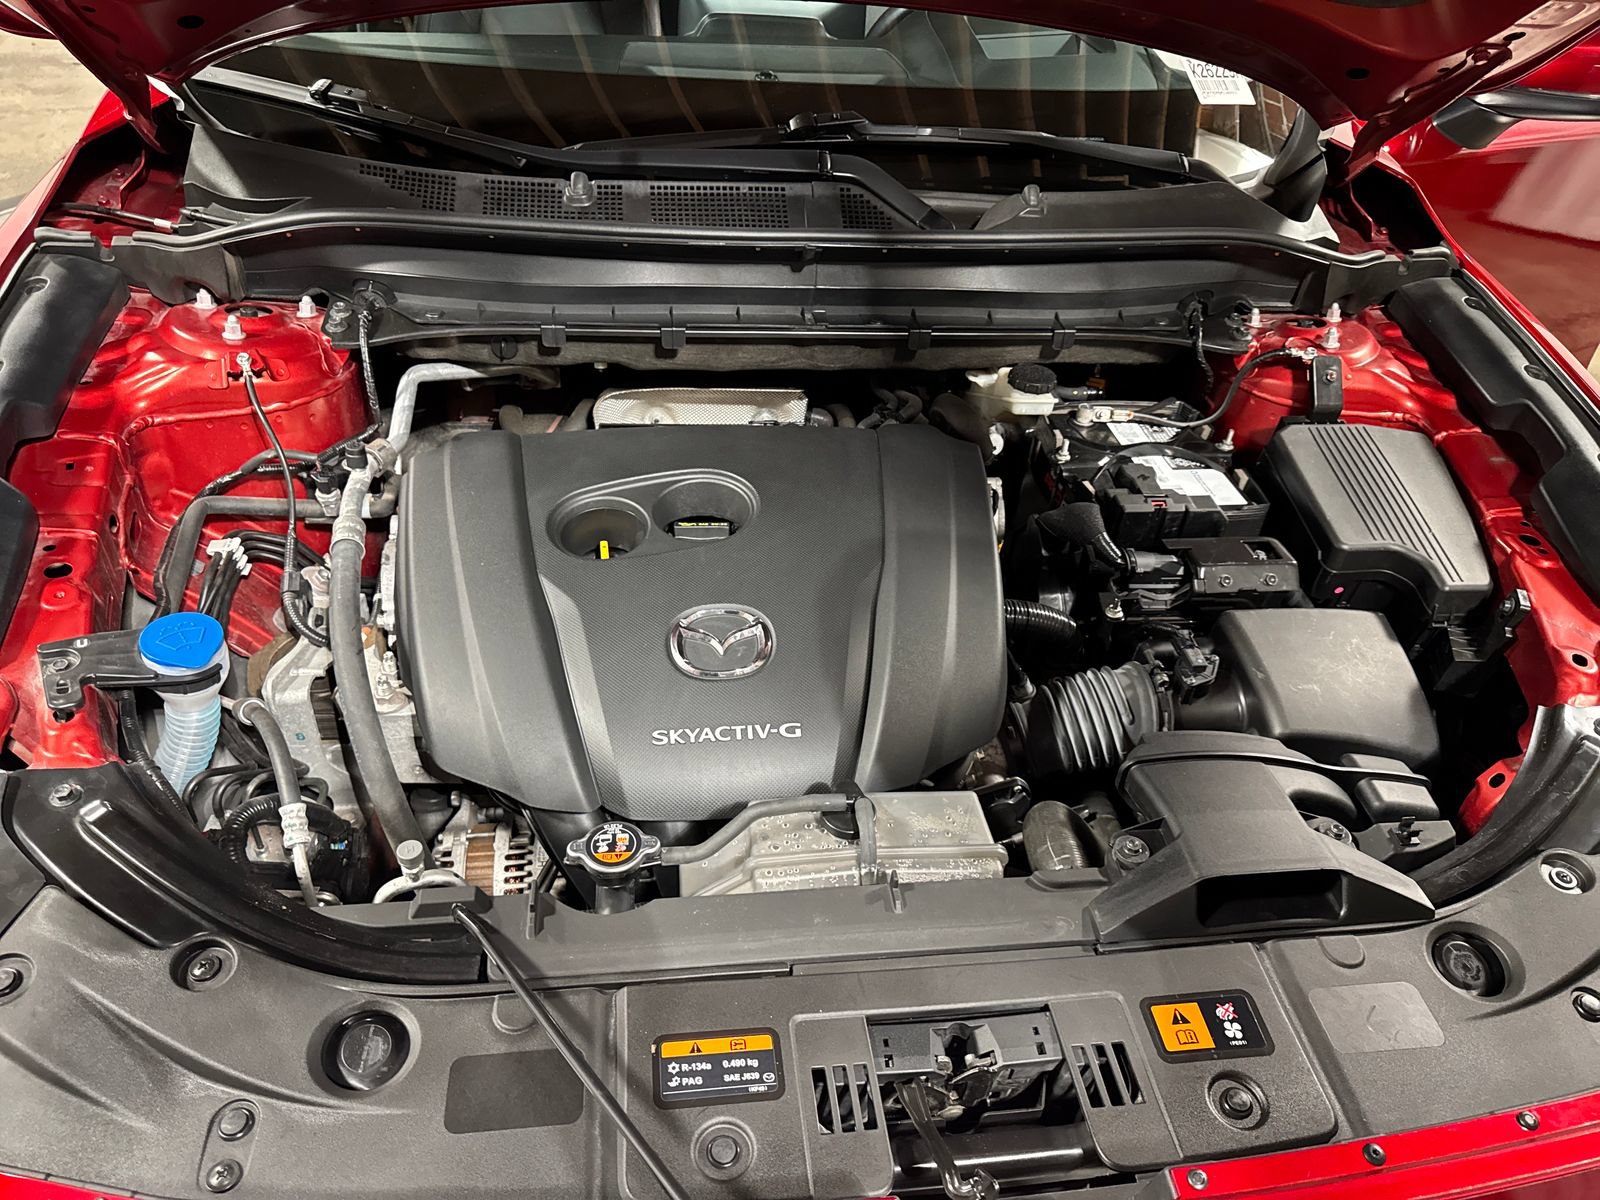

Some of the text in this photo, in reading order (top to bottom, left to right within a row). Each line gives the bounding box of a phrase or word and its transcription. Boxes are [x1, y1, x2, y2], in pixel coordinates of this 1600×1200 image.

[651, 722, 802, 745] SKYACTIV-G
[681, 1058, 759, 1072] R-134a 0.490 kg
[681, 1076, 703, 1086] PAG
[723, 1073, 740, 1082] SAE
